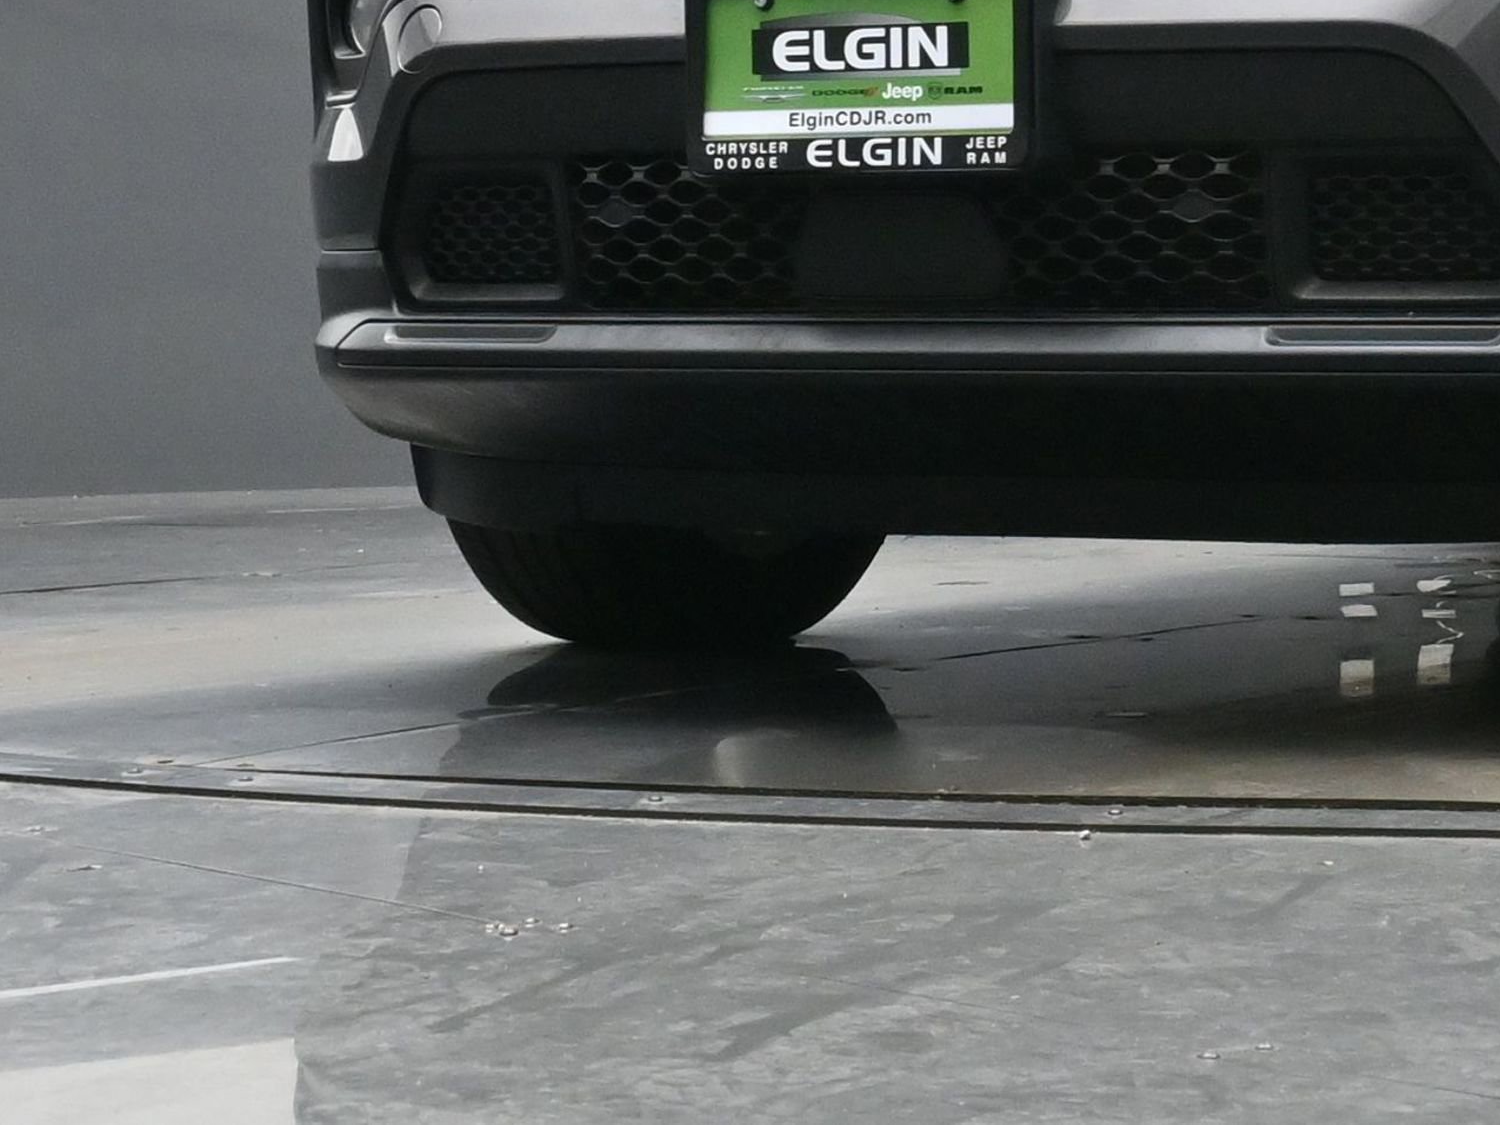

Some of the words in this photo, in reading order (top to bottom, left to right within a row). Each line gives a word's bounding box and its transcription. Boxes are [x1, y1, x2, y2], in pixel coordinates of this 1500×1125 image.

[772, 26, 949, 72] ELGIN
[882, 83, 924, 101] Jeep
[944, 86, 983, 94] RAM
[788, 111, 932, 130] ElginCDJR.com
[705, 141, 788, 155] CHRYSLER
[966, 136, 1007, 149] JEEP
[806, 138, 942, 168] ELGIN
[966, 151, 1007, 165] RAM
[714, 157, 779, 170] DODGE
